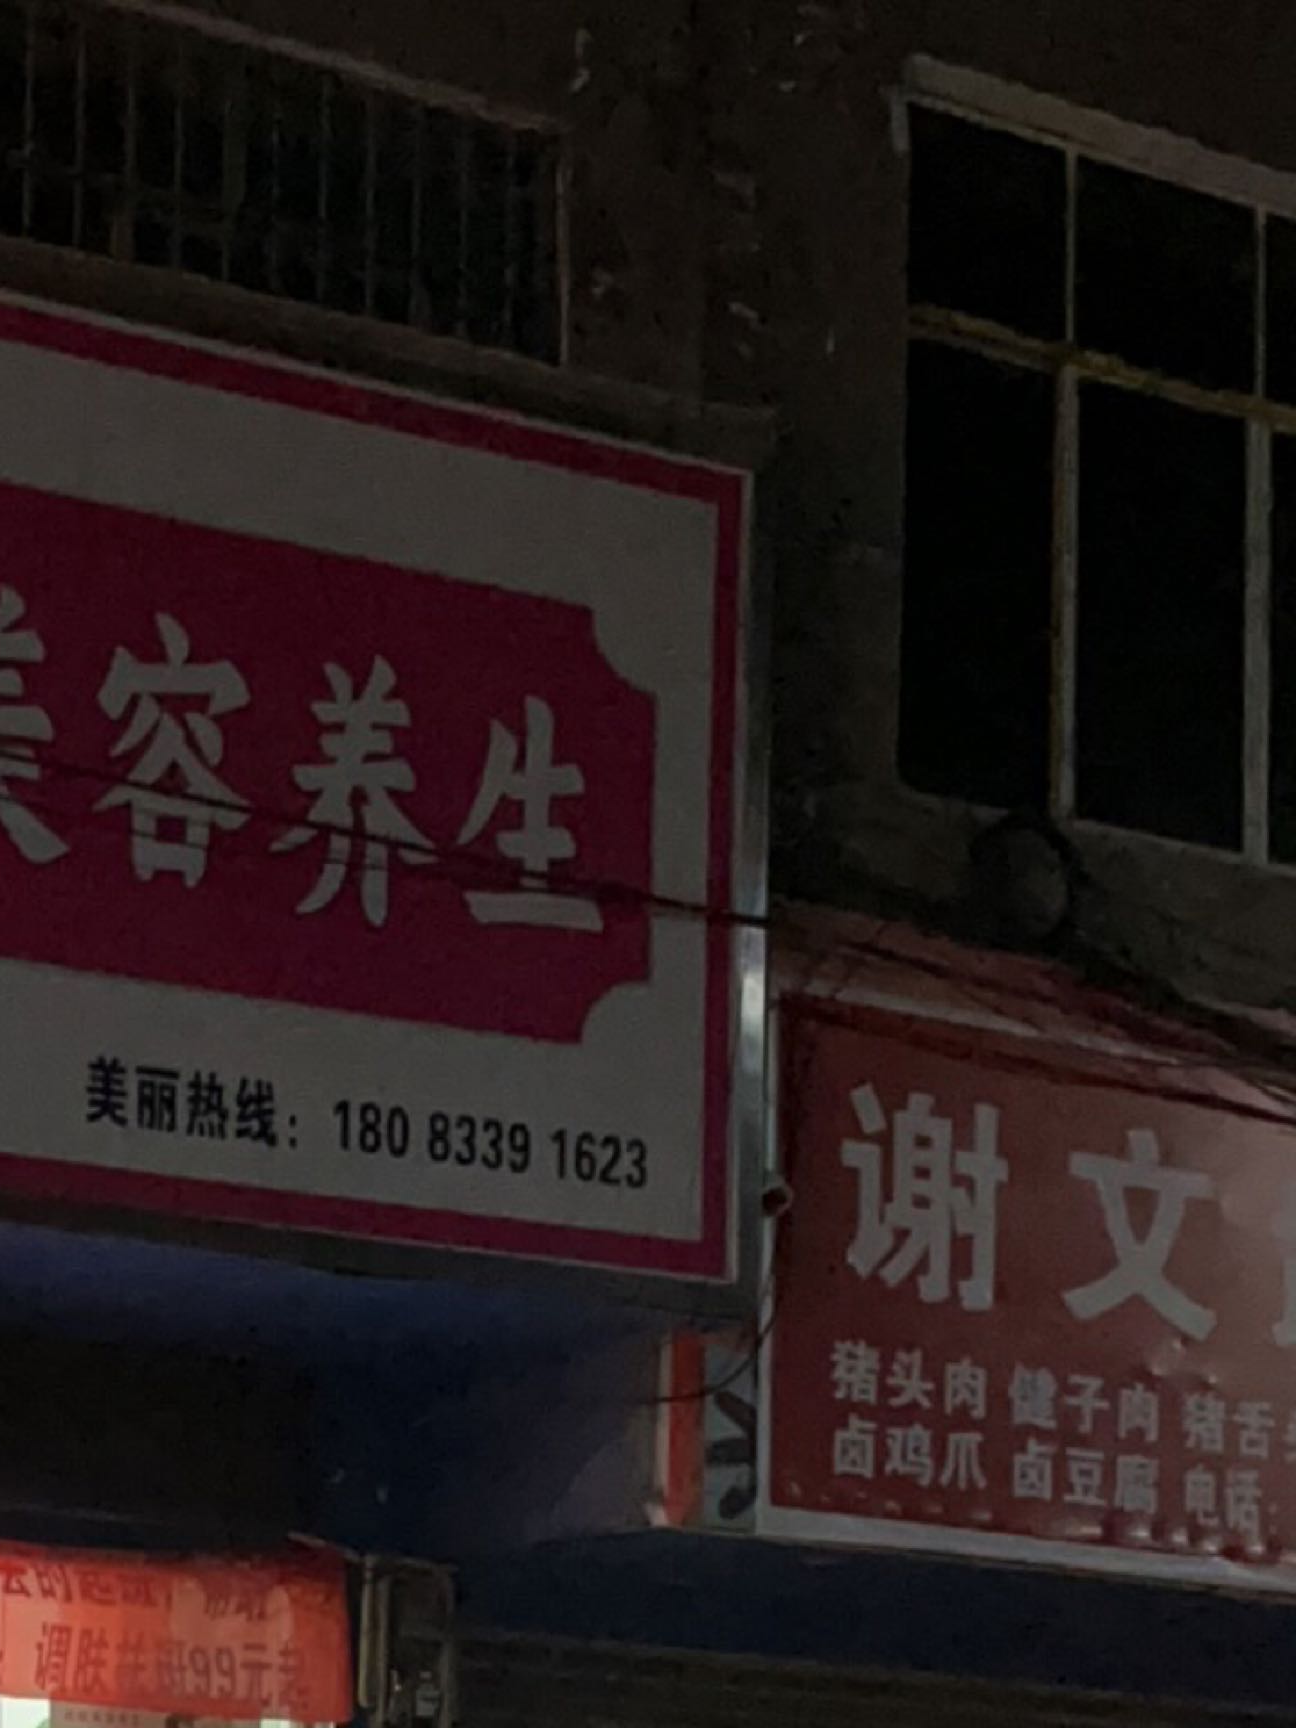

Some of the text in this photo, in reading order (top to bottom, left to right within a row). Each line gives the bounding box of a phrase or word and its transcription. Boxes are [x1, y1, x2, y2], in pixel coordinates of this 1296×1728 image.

[86, 1055, 648, 1190] 美丽热线： 180 8339 1623
[830, 1338, 988, 1421] 猪头肉
[832, 1412, 989, 1491] 卤鸡爪
